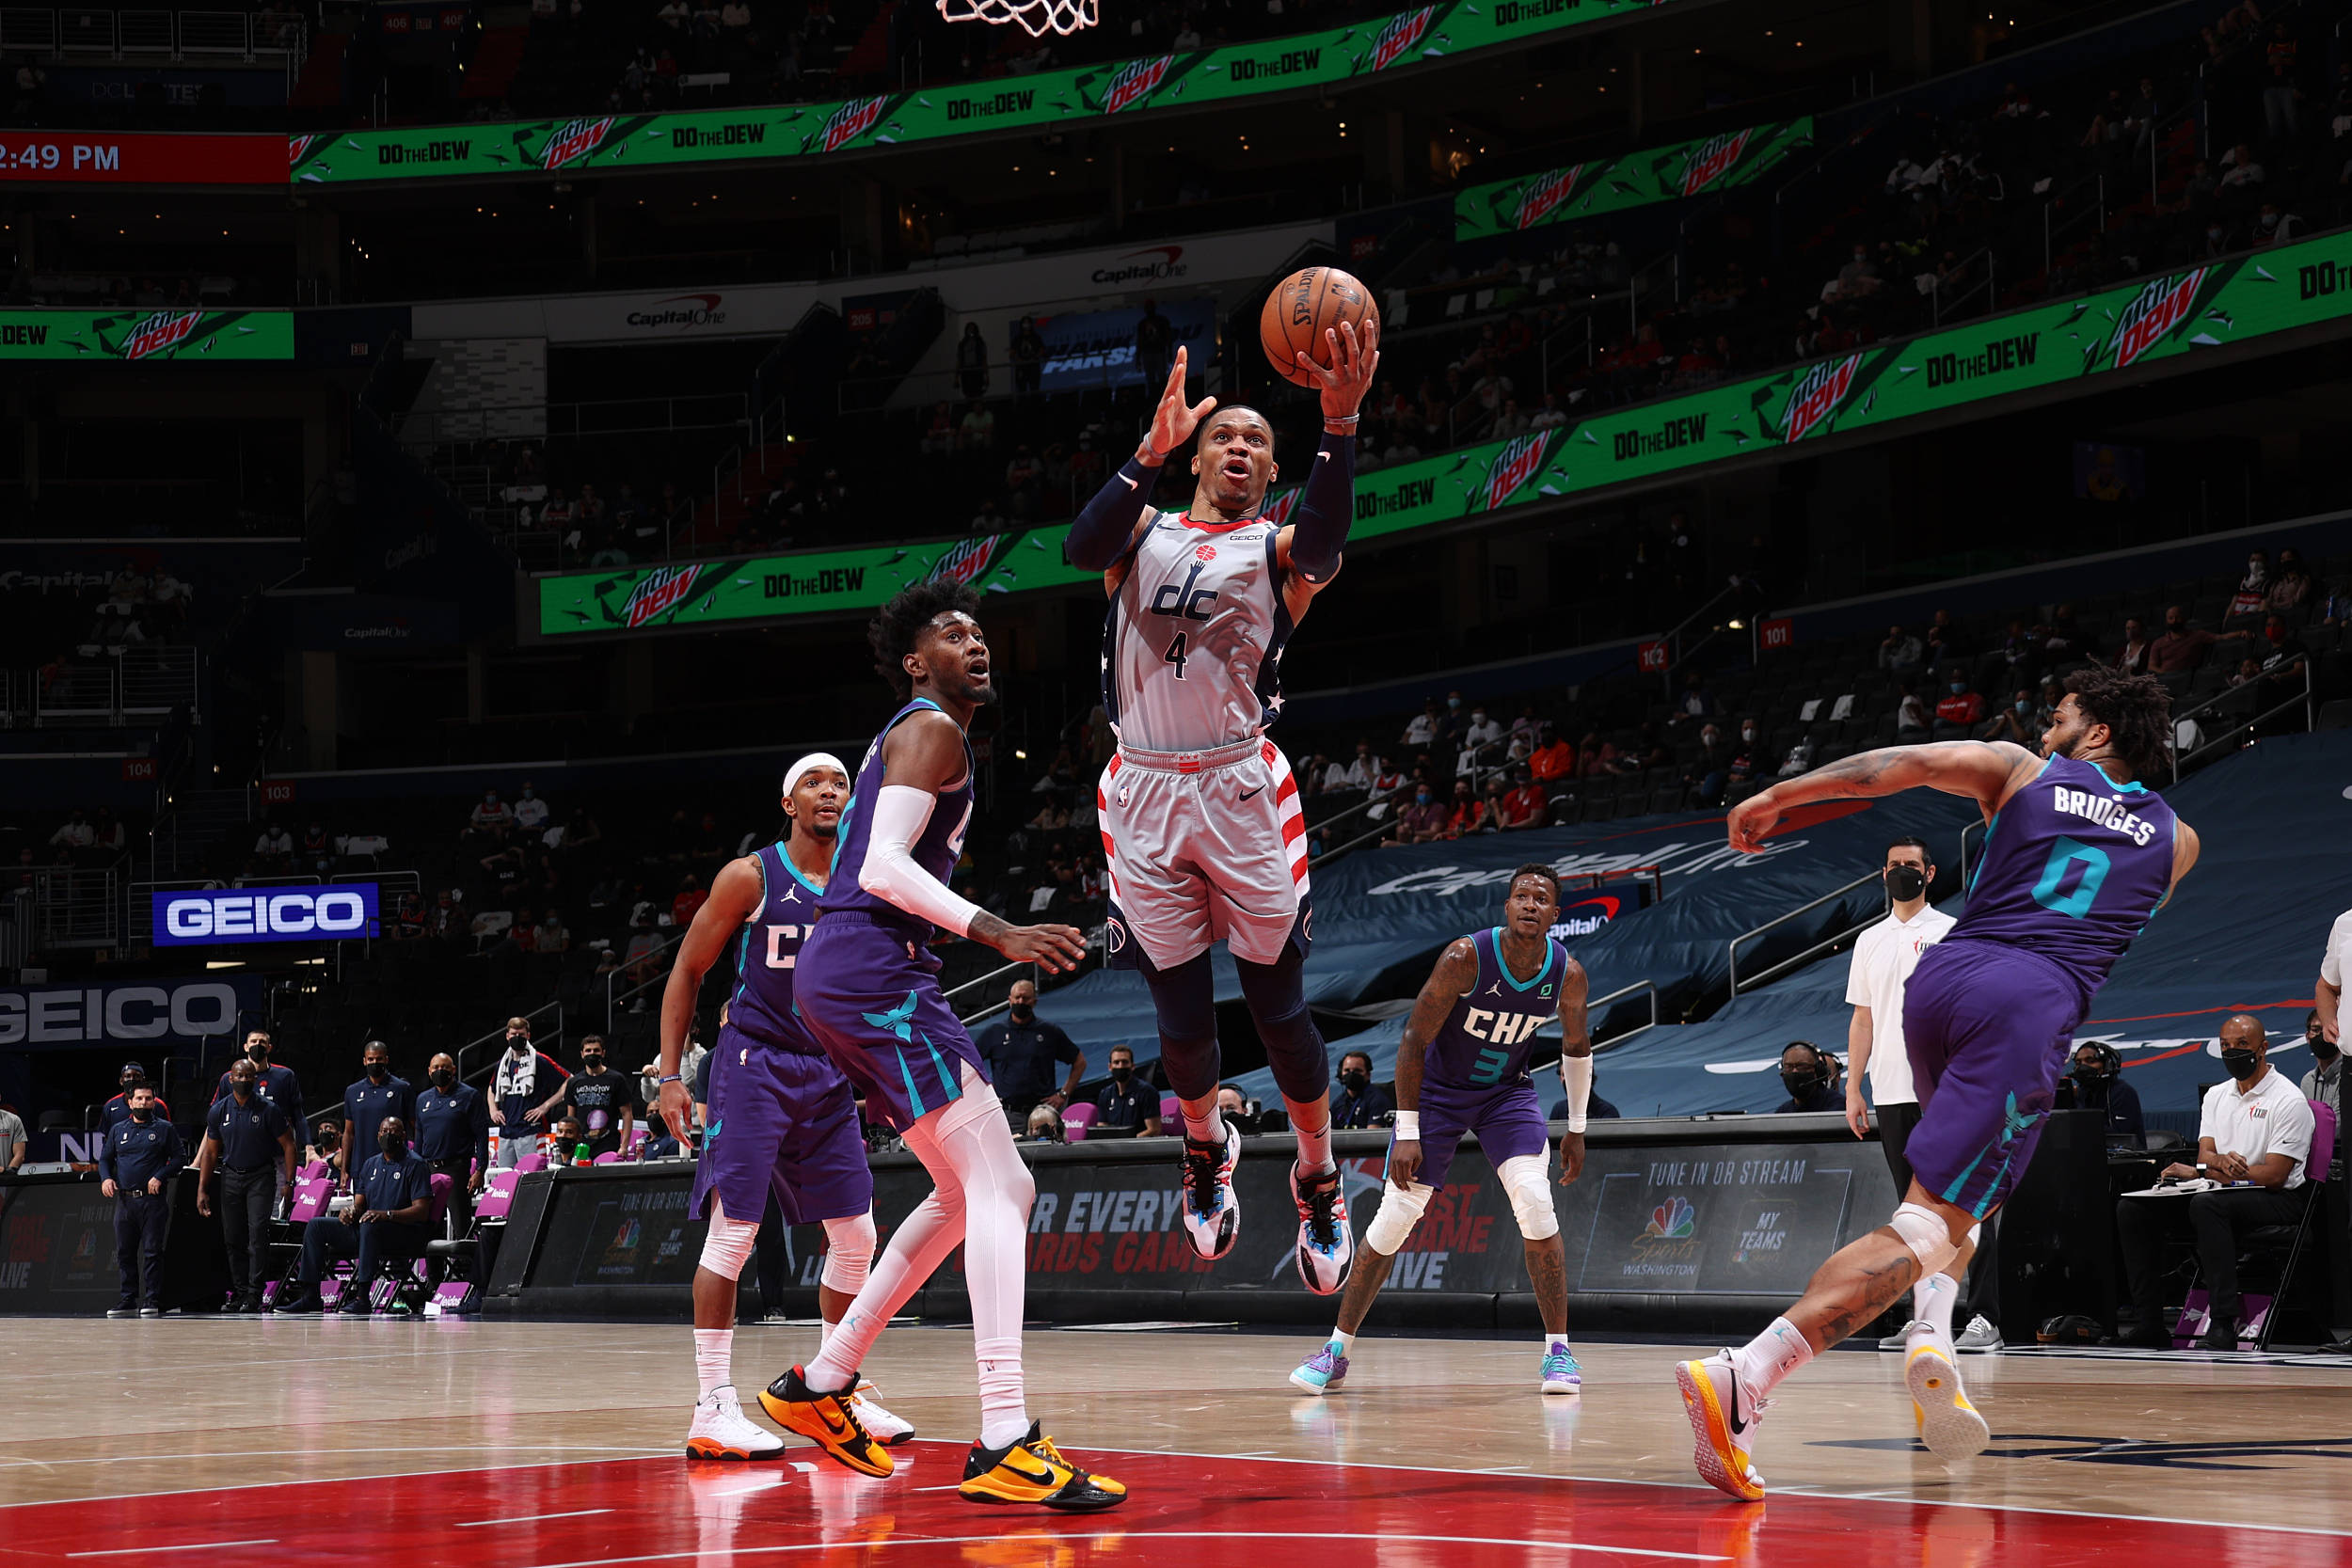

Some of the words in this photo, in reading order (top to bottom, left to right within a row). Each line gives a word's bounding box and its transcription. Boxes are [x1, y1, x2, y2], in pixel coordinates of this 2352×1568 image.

[72, 145, 119, 171] PM
[851, 313, 873, 326] 205
[1766, 626, 1788, 645] 101
[1164, 631, 1188, 680] 4
[127, 763, 151, 776] 104
[265, 785, 291, 800] 103
[2055, 785, 2155, 847] BRIDGES
[2031, 835, 2111, 919] 0
[167, 891, 365, 939] GEICO
[1469, 1048, 1509, 1084] 3
[1648, 1162, 1688, 1187] TUNE
[1692, 1161, 1709, 1185] IN
[1713, 1160, 1736, 1184] OR
[1740, 1159, 1806, 1184] STREAM
[1064, 1190, 1184, 1233] EVERY
[1756, 1212, 1781, 1229] MY
[1740, 1230, 1785, 1251] TEAMS
[1380, 1252, 1449, 1289] IVE
[1623, 1263, 1696, 1276] WASHINGTON
